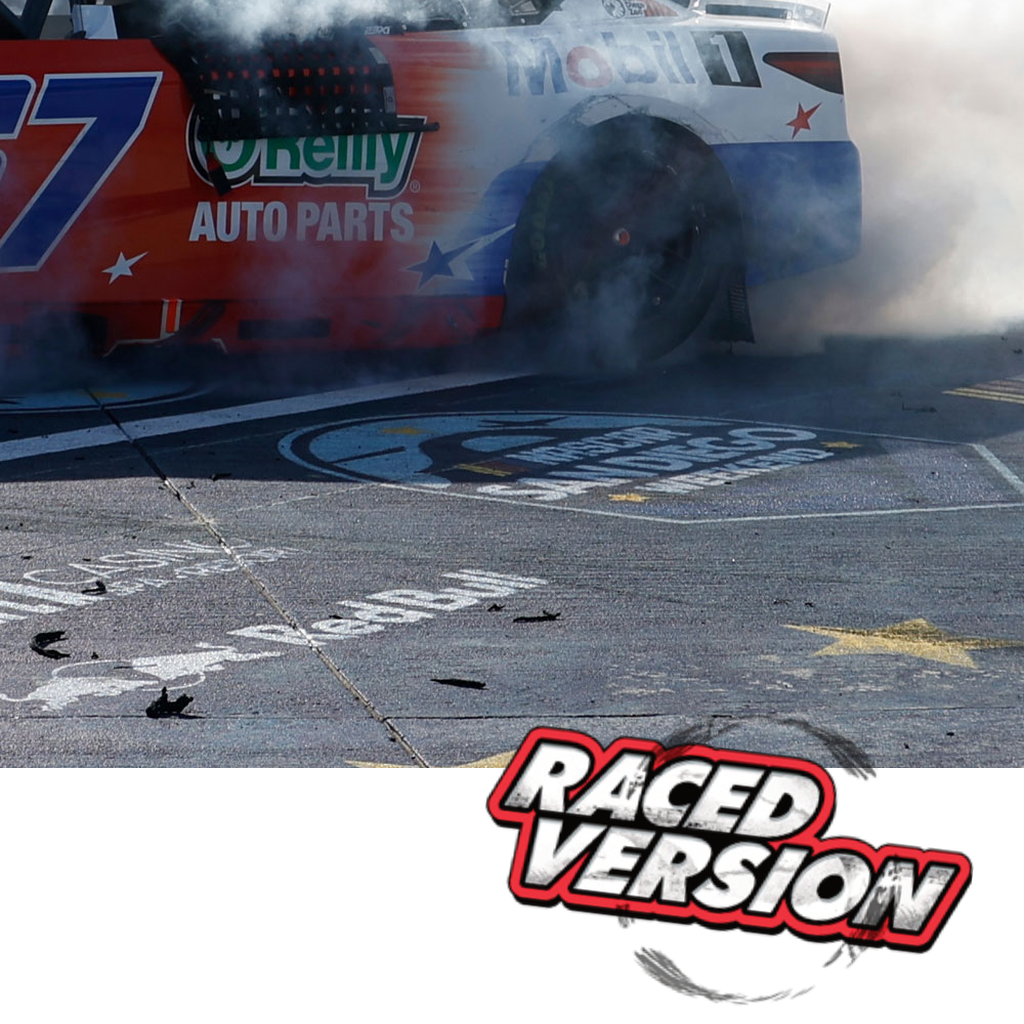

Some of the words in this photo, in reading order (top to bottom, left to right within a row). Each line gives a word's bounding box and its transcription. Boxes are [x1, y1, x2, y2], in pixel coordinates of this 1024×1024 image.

[492, 30, 696, 97] Mobil
[188, 200, 288, 242] AUTO
[296, 200, 415, 242] PARTS
[477, 465, 659, 501] SAN
[600, 427, 817, 472] DIEGO
[505, 426, 693, 466] NASCAR
[634, 448, 836, 495] WEEKEND
[226, 600, 436, 647] Red
[365, 569, 549, 612] Bull
